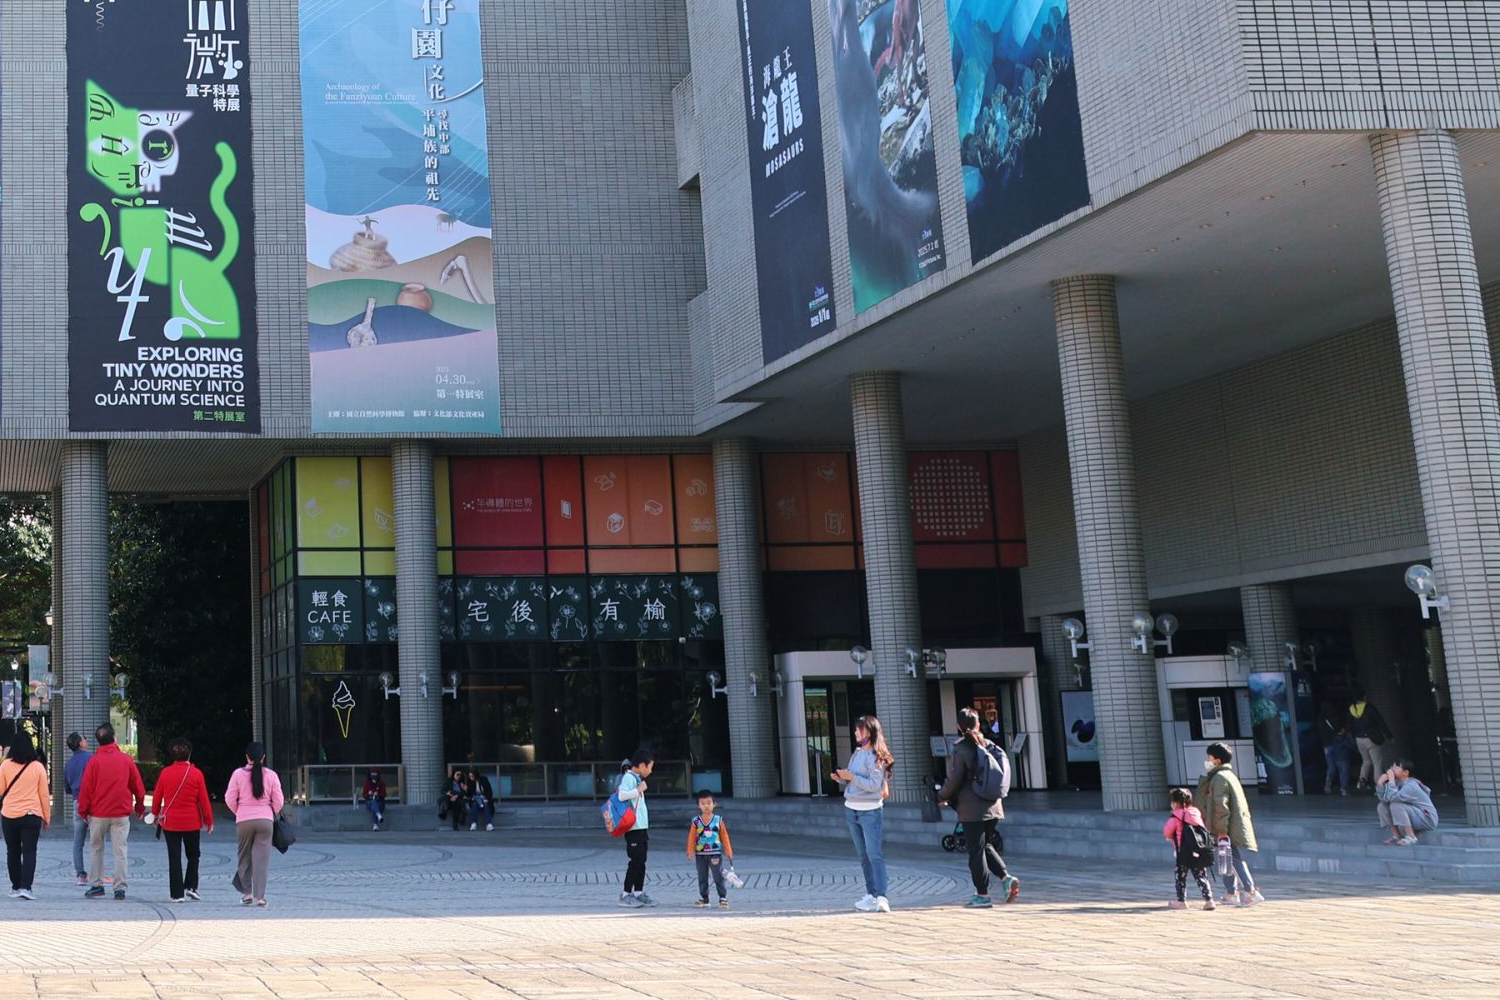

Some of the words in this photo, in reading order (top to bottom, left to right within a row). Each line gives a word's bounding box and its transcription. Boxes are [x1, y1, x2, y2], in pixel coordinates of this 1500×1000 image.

[185, 83, 240, 98] 量子科學
[325, 83, 371, 91] Archaeology
[371, 82, 381, 90] of
[427, 64, 445, 101] 文化
[325, 92, 339, 101] the
[384, 92, 417, 101] Culture
[213, 98, 241, 112] 特展
[762, 71, 803, 152] 滄龍
[438, 109, 451, 155] 尋找中部
[423, 109, 441, 202] 平埔族的祖先
[765, 137, 804, 178] MOSASAURS
[137, 346, 244, 362] EXPLORING
[102, 363, 149, 378] TINY
[150, 363, 245, 379] WONDERS
[114, 380, 125, 392] A
[129, 380, 202, 392] JOURNEY
[207, 380, 245, 393] INTO
[435, 374, 466, 385] 04.30
[94, 393, 176, 406] QUANTUM
[180, 394, 246, 407] SCIENCE
[193, 410, 246, 422] 第二特展室
[311, 589, 348, 608] 輕食
[307, 609, 353, 625] CAFE
